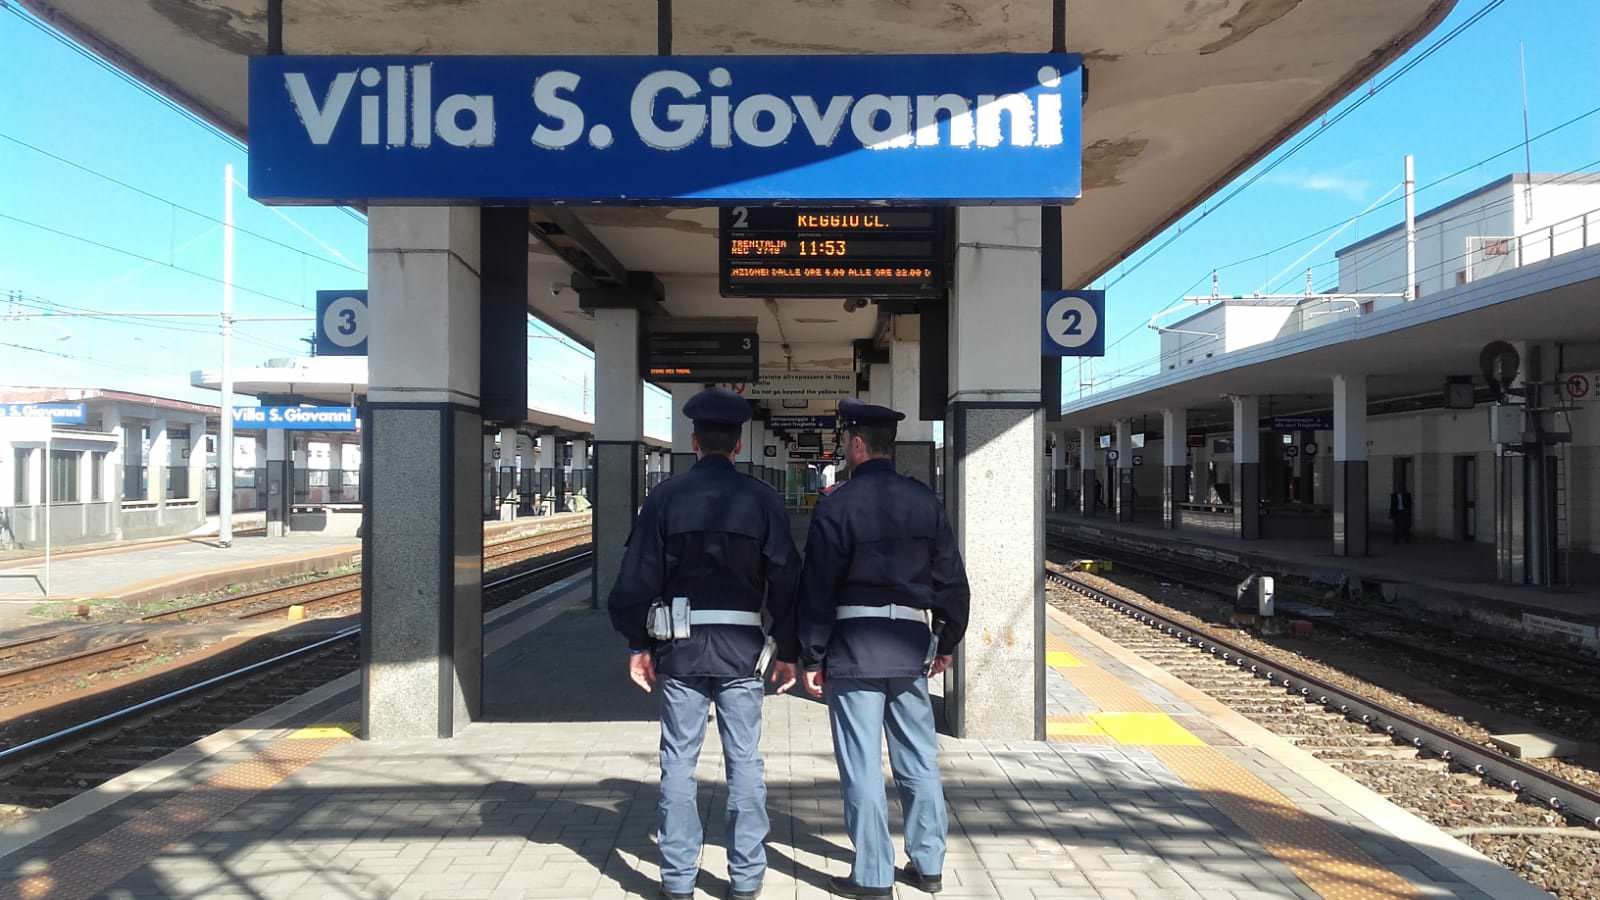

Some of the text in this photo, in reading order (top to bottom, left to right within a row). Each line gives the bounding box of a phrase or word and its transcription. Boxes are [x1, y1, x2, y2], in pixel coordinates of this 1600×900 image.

[283, 63, 1064, 150] Villa S. Giovanni
[731, 206, 749, 229] 2
[731, 240, 787, 248] TRENITALIA
[799, 240, 847, 256] 11:53
[337, 308, 357, 335] 3
[1062, 309, 1082, 335] 2
[742, 338, 752, 350] 3
[782, 388, 805, 396] beyond
[817, 388, 837, 396] yellow
[232, 406, 351, 422] Villa S. Giovanni
